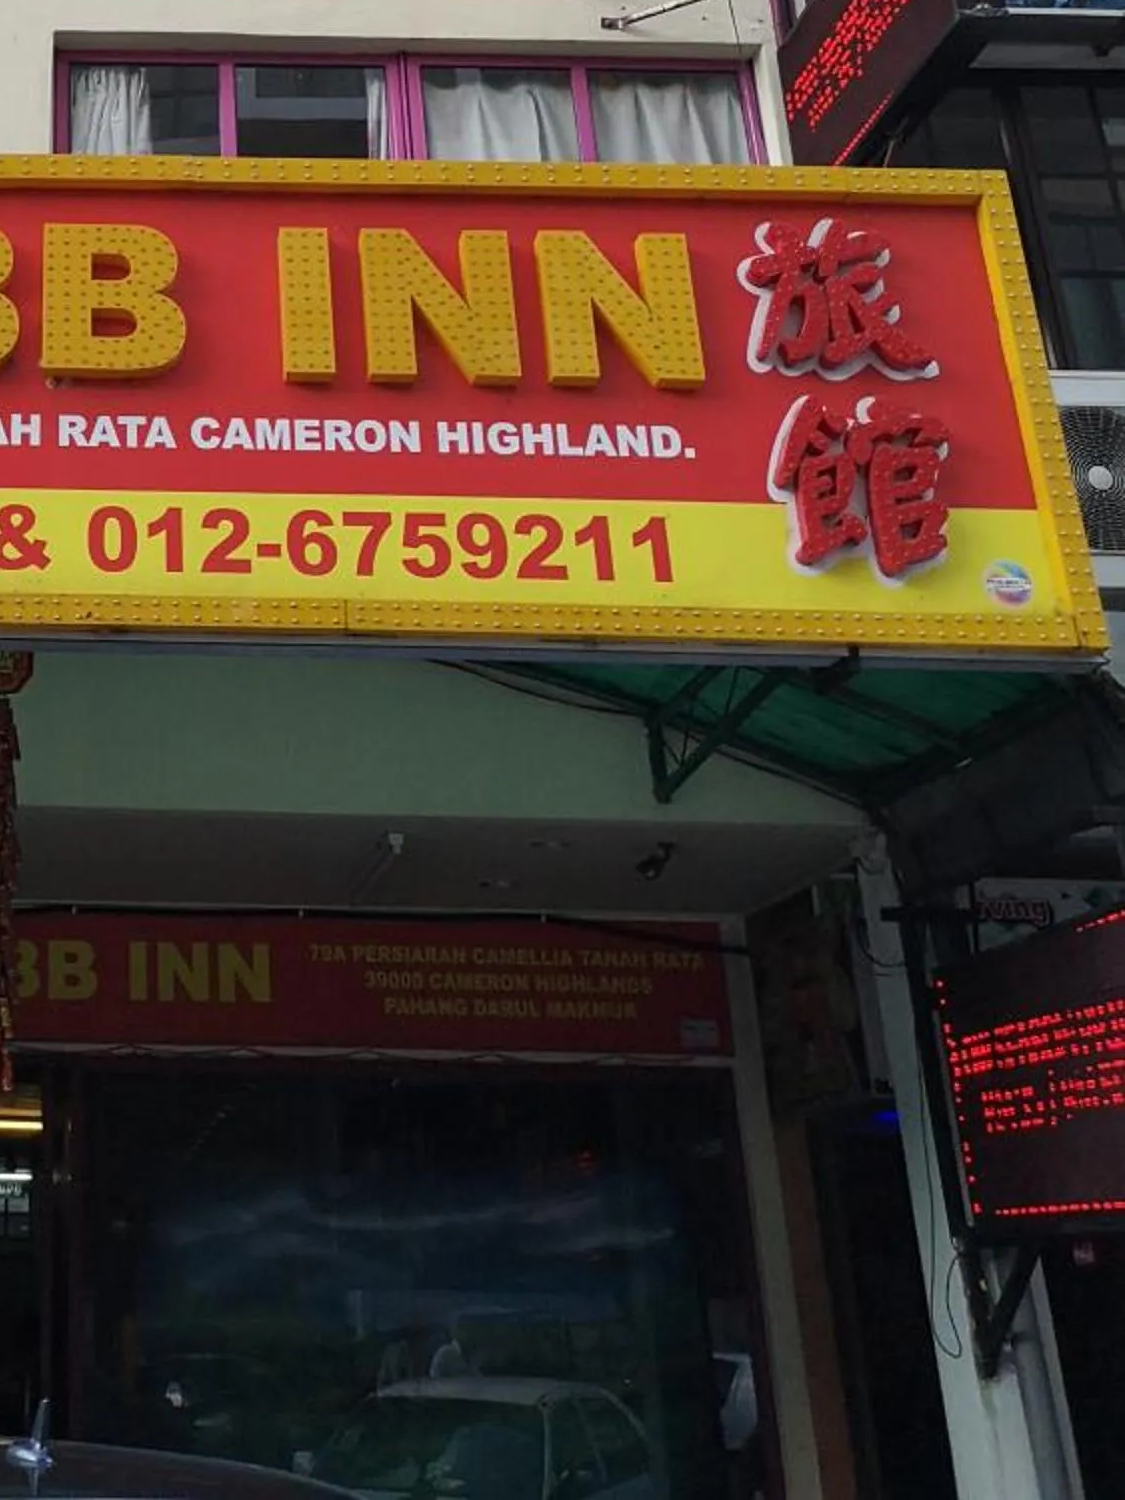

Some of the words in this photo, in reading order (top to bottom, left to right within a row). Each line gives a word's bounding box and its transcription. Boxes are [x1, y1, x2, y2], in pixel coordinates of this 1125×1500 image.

[277, 226, 706, 390] INN
[57, 414, 178, 450] RATA
[190, 417, 422, 454] CAMERON
[436, 420, 697, 459] HIGHLAND.
[87, 505, 674, 583] 012-6759211
[127, 940, 274, 1004] INN
[472, 945, 574, 968] CAMELLIA
[577, 949, 648, 969] TANAH
[427, 970, 529, 992] CAMERON
[534, 973, 653, 995] HIGHLANDS
[383, 996, 468, 1016] PAHANG
